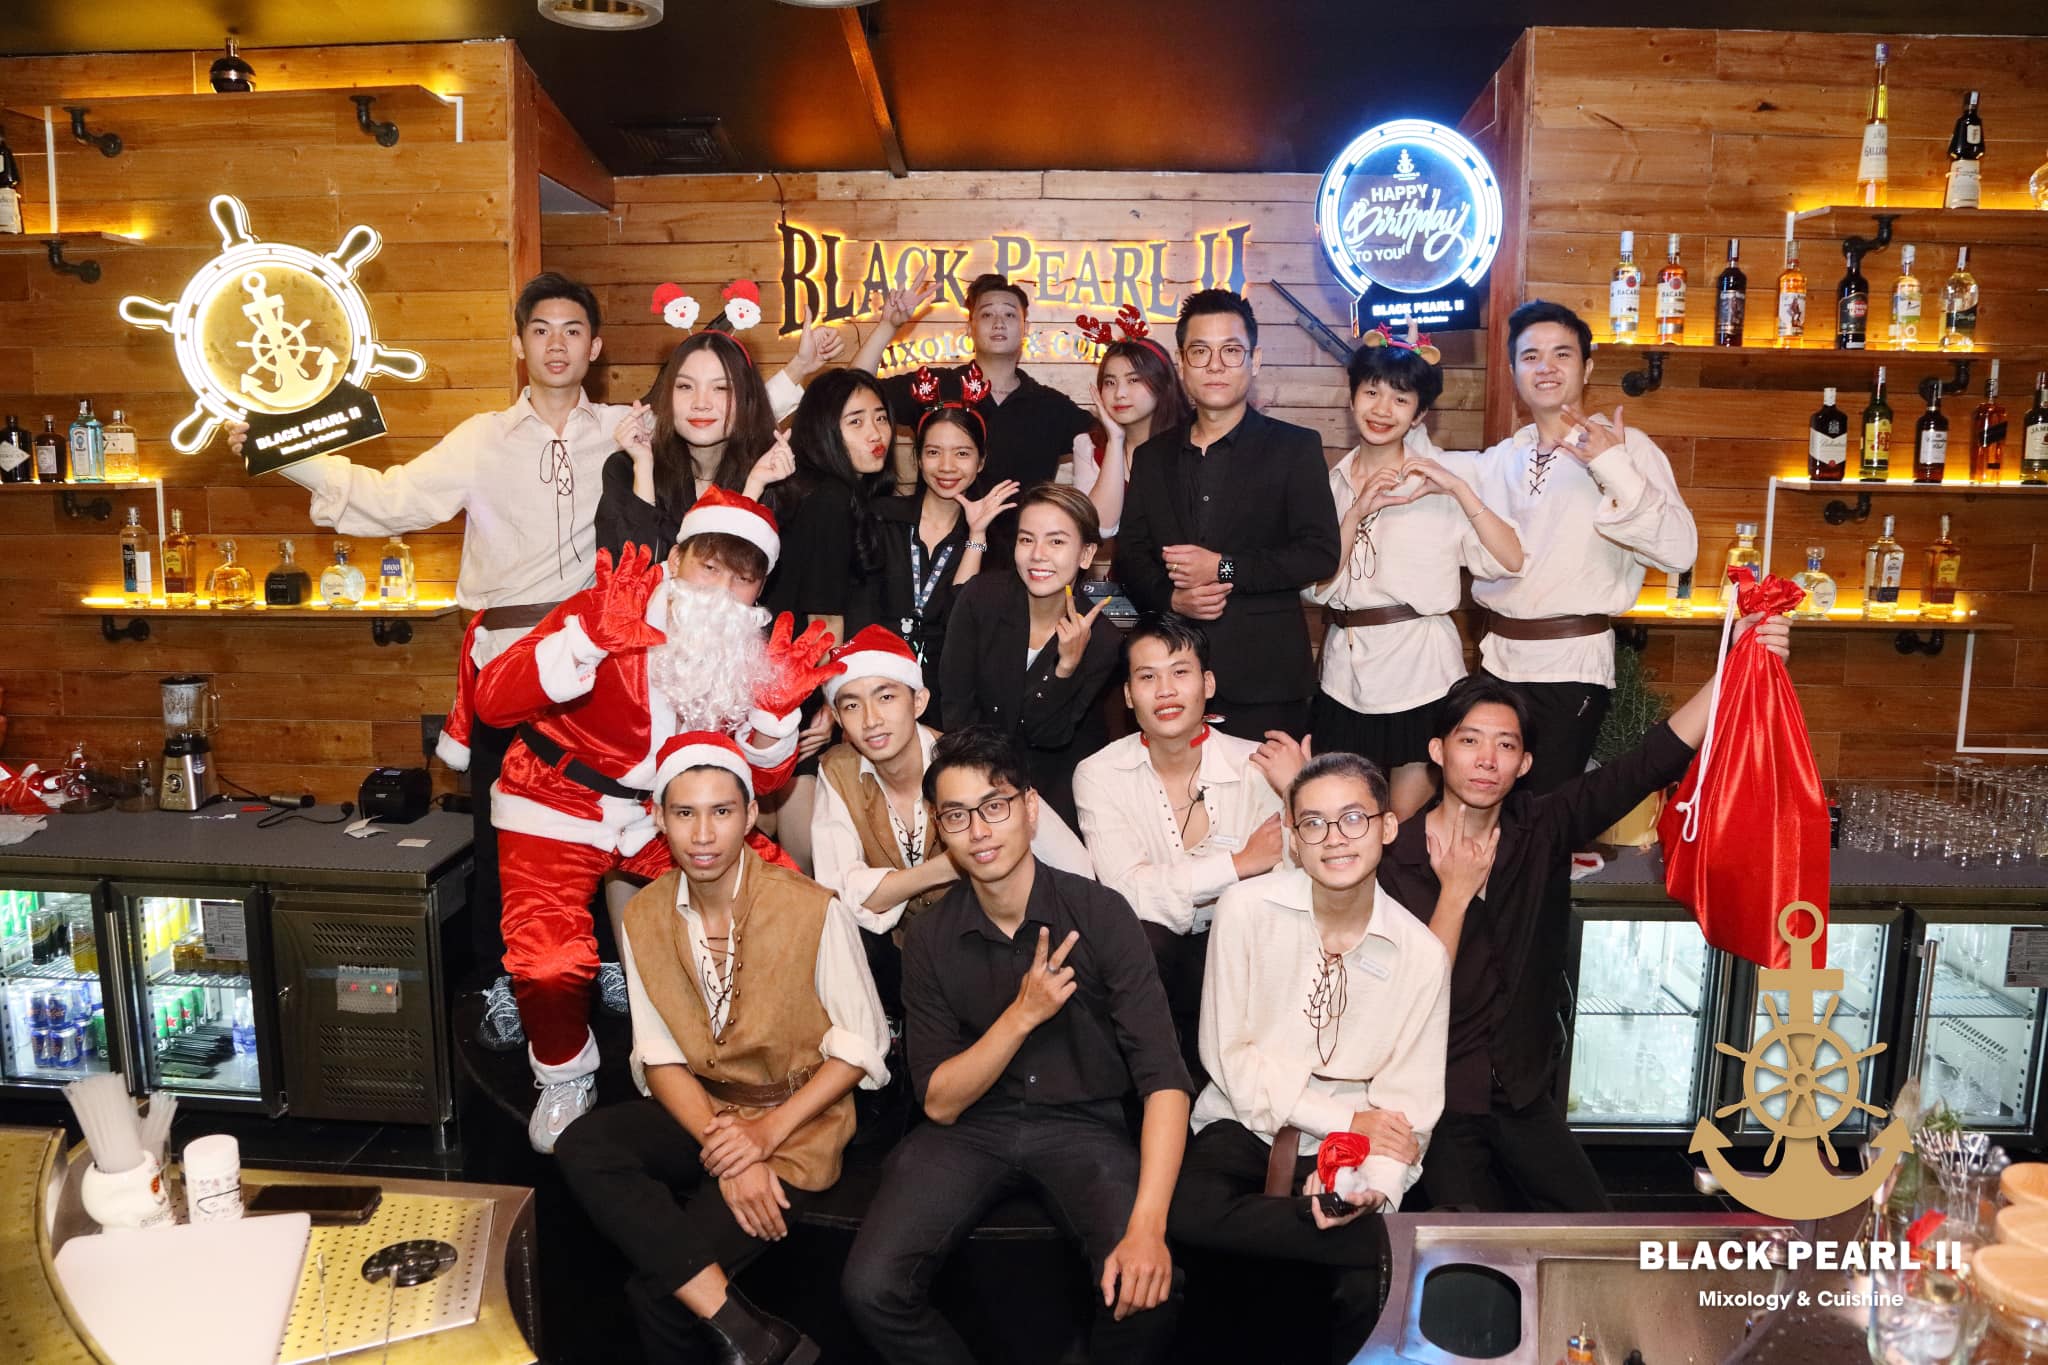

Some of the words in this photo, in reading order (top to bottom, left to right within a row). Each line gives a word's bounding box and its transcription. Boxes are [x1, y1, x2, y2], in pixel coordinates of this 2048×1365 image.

[1371, 184, 1428, 202] HAPPY
[1342, 188, 1471, 262] Birthday
[1355, 250, 1373, 263] TO
[1375, 248, 1402, 261] YOU
[777, 222, 970, 336] BLACK
[992, 234, 1181, 336] PEARL
[1199, 224, 1251, 301] II
[1372, 302, 1412, 316] BLACK
[1413, 300, 1453, 314] PEARL
[1454, 299, 1465, 311] II
[1027, 331, 1046, 354] &
[255, 426, 303, 450] BLACK
[302, 411, 349, 435] PEARL
[348, 406, 362, 420] II
